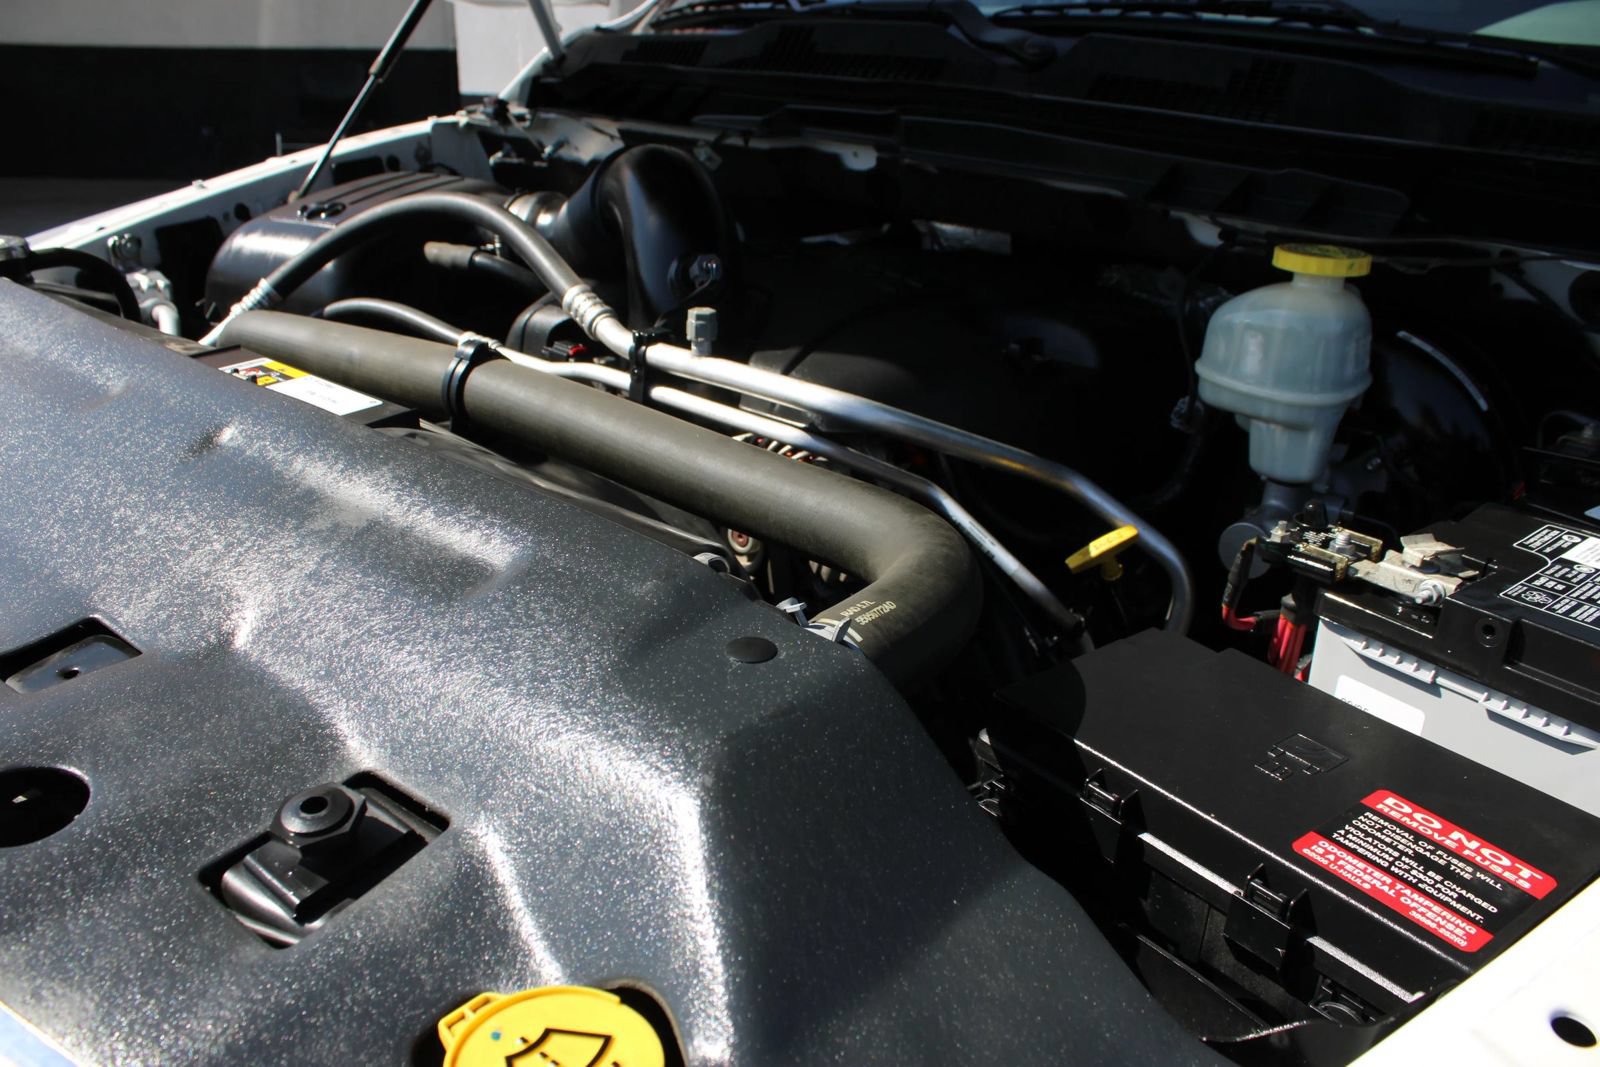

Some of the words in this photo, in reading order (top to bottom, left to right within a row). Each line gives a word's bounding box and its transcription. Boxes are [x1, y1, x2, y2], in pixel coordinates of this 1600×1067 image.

[1331, 832, 1390, 867] TAMPERING
[1389, 865, 1418, 883] WITH
[1344, 824, 1401, 857] VIOLATORS
[1400, 855, 1427, 872] WILL
[1427, 870, 1443, 881] BE
[1443, 879, 1499, 913] CHARGED
[1346, 833, 1394, 861] MINIMUM
[1394, 860, 1410, 870] OF
[1435, 883, 1459, 898] FOR
[1352, 819, 1417, 856] ODOMETER.
[1358, 815, 1382, 829] NOT
[1383, 828, 1447, 865] DISENGAGE
[1448, 864, 1473, 880] THE
[1364, 811, 1417, 841] REMOVAL
[1418, 840, 1435, 851] OF
[1436, 850, 1474, 872] FUSES
[1475, 871, 1505, 890] WILL
[1376, 803, 1459, 848] REMOVE
[1462, 849, 1532, 889] FUSES
[1383, 796, 1445, 830] DO
[1448, 830, 1543, 883] NOT
[1311, 844, 1326, 854] IS
[1325, 852, 1338, 861] A
[1337, 859, 1399, 897] FEDERAL
[1399, 895, 1470, 939] OFFENSE.
[1317, 839, 1393, 884] ODOMETER
[1393, 882, 1478, 934] TAMPERING
